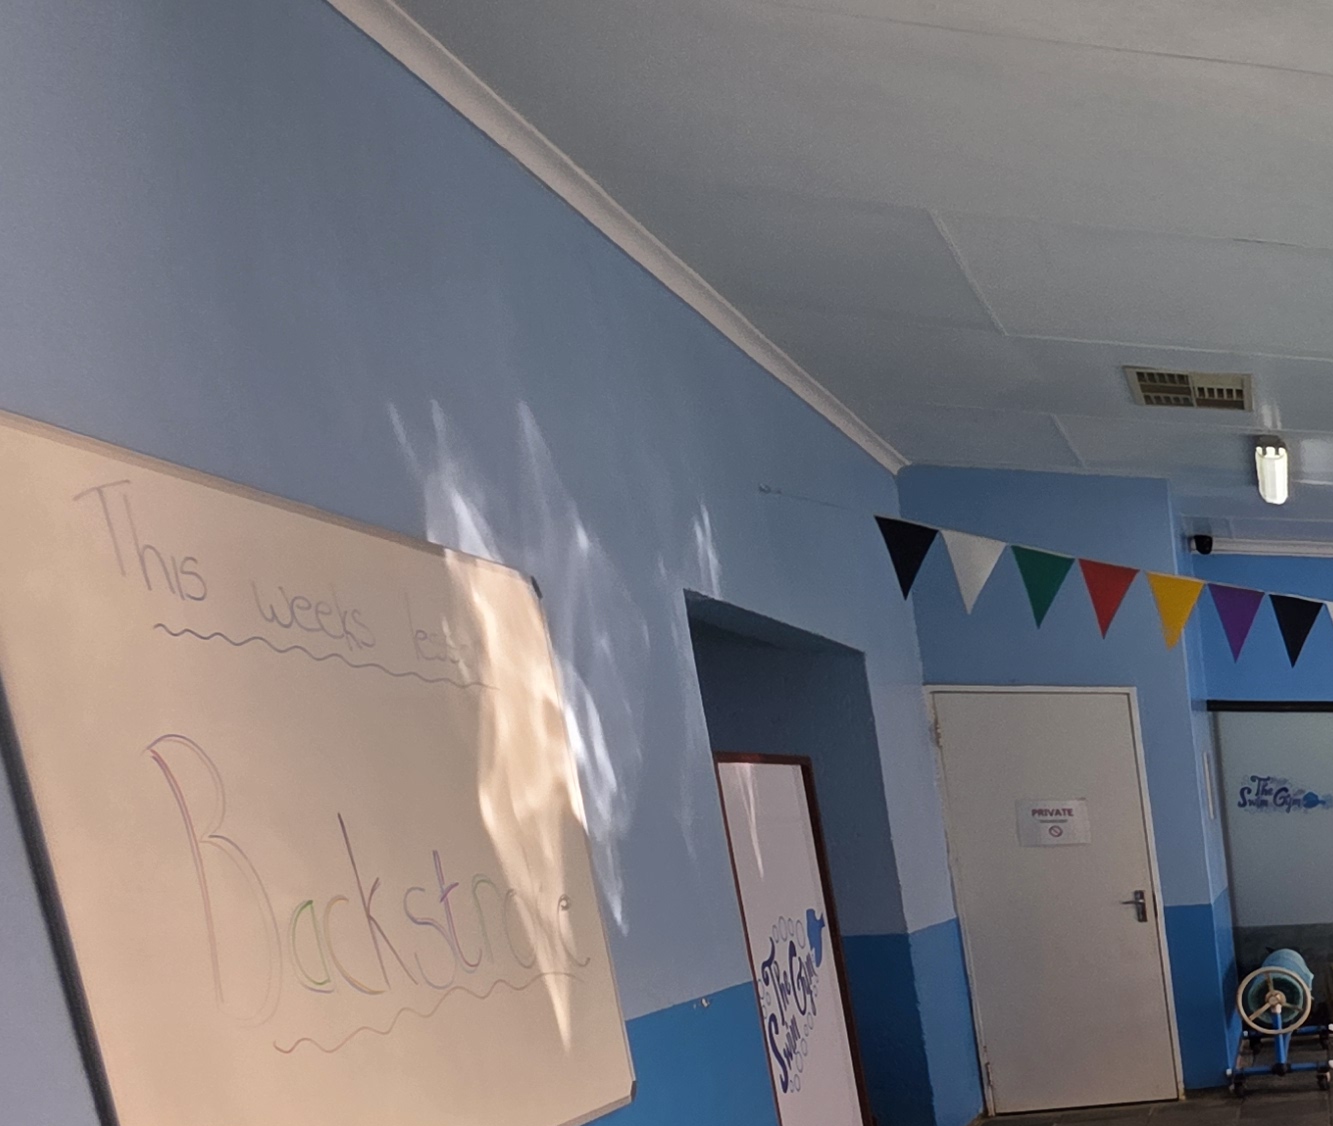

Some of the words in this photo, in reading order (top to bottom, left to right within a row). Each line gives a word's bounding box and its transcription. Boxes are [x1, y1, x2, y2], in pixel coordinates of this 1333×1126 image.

[73, 479, 208, 602] This
[251, 578, 377, 653] weeks
[1031, 808, 1074, 817] PRIVATE
[1238, 786, 1268, 808] Swim
[1273, 786, 1300, 814] Gym
[1250, 775, 1274, 797] The
[141, 733, 590, 1028] Backstroe
[761, 936, 791, 1027] The
[768, 1012, 802, 1094] Swim
[788, 940, 818, 1017] Gym
